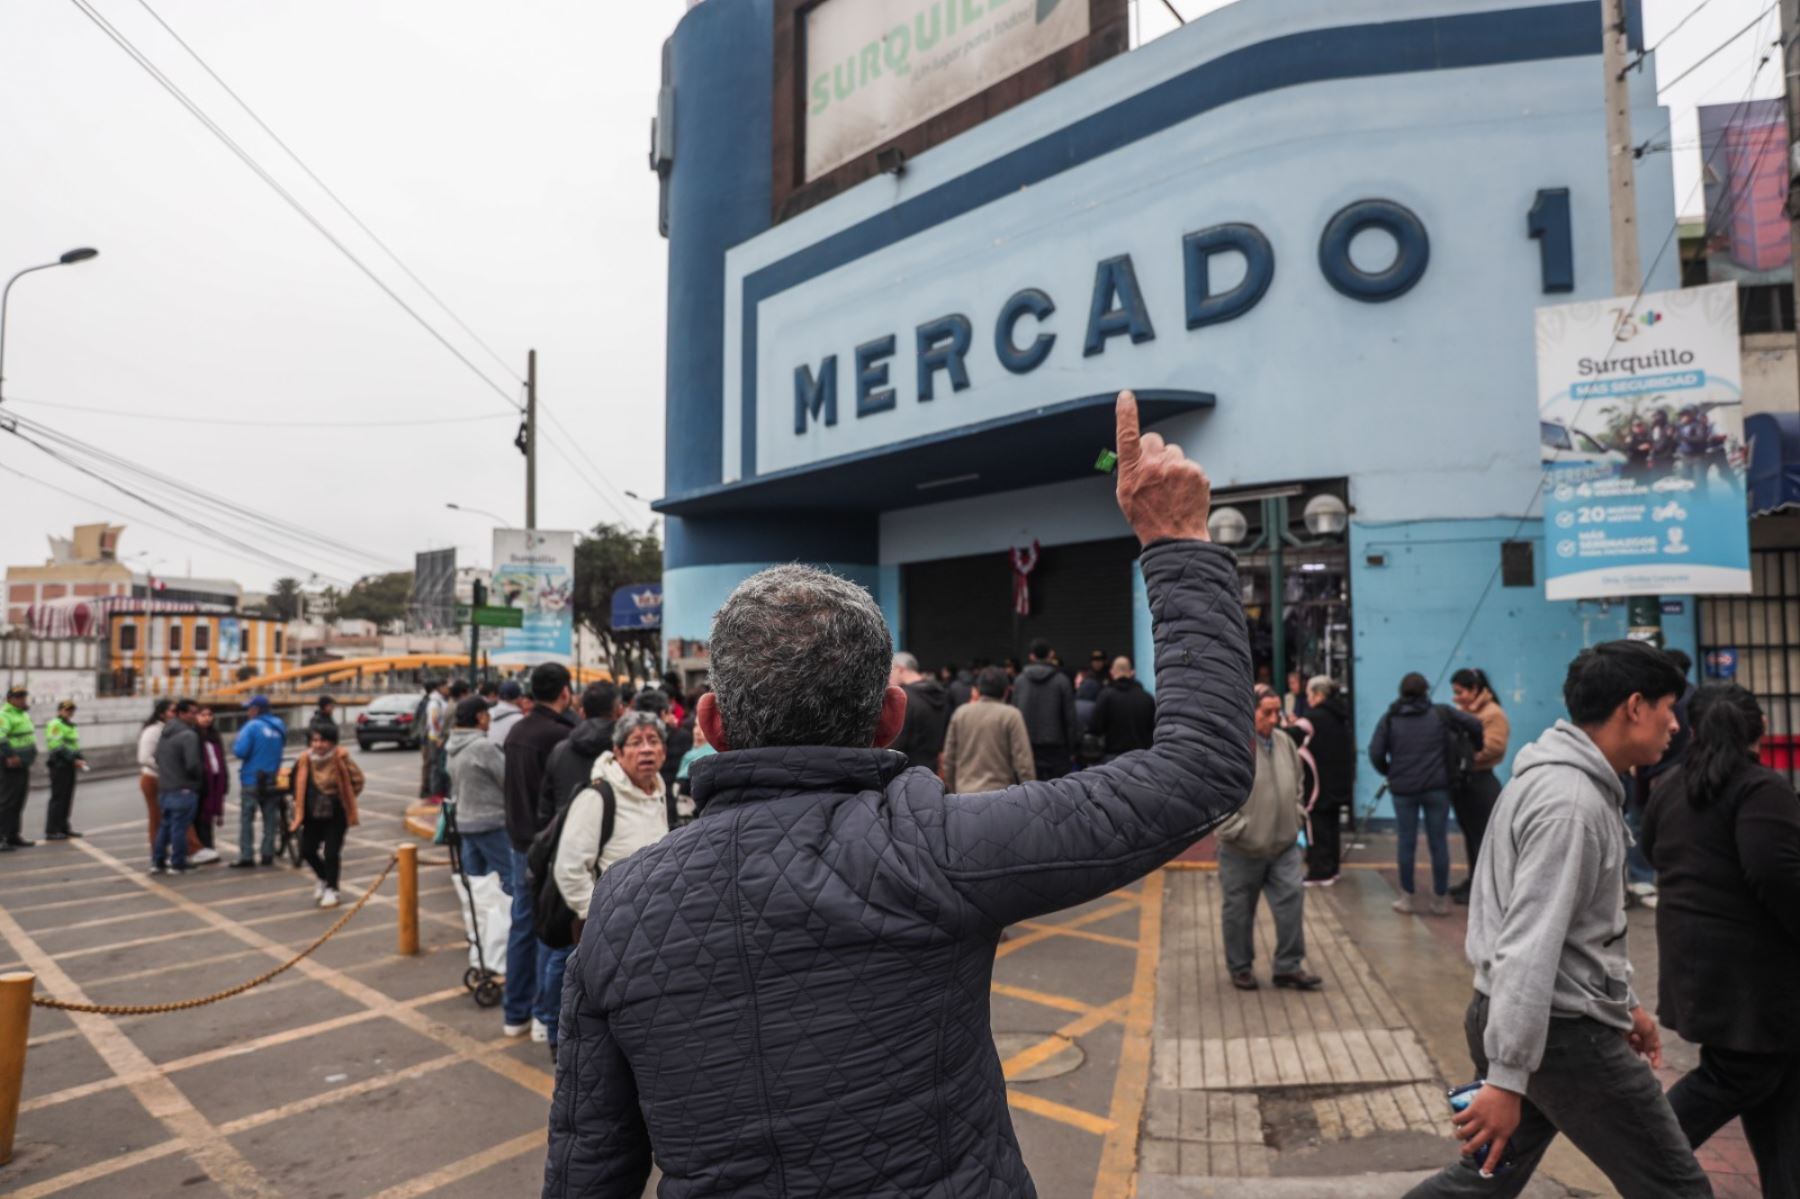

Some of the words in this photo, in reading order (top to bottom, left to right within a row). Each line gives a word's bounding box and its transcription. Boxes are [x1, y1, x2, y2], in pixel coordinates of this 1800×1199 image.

[794, 197, 1431, 436] MERCADO
[1527, 187, 1575, 294] 1
[1577, 348, 1695, 377] Surquillo
[1611, 373, 1698, 394] SEGURIDAD
[1577, 506, 1606, 524] 20
